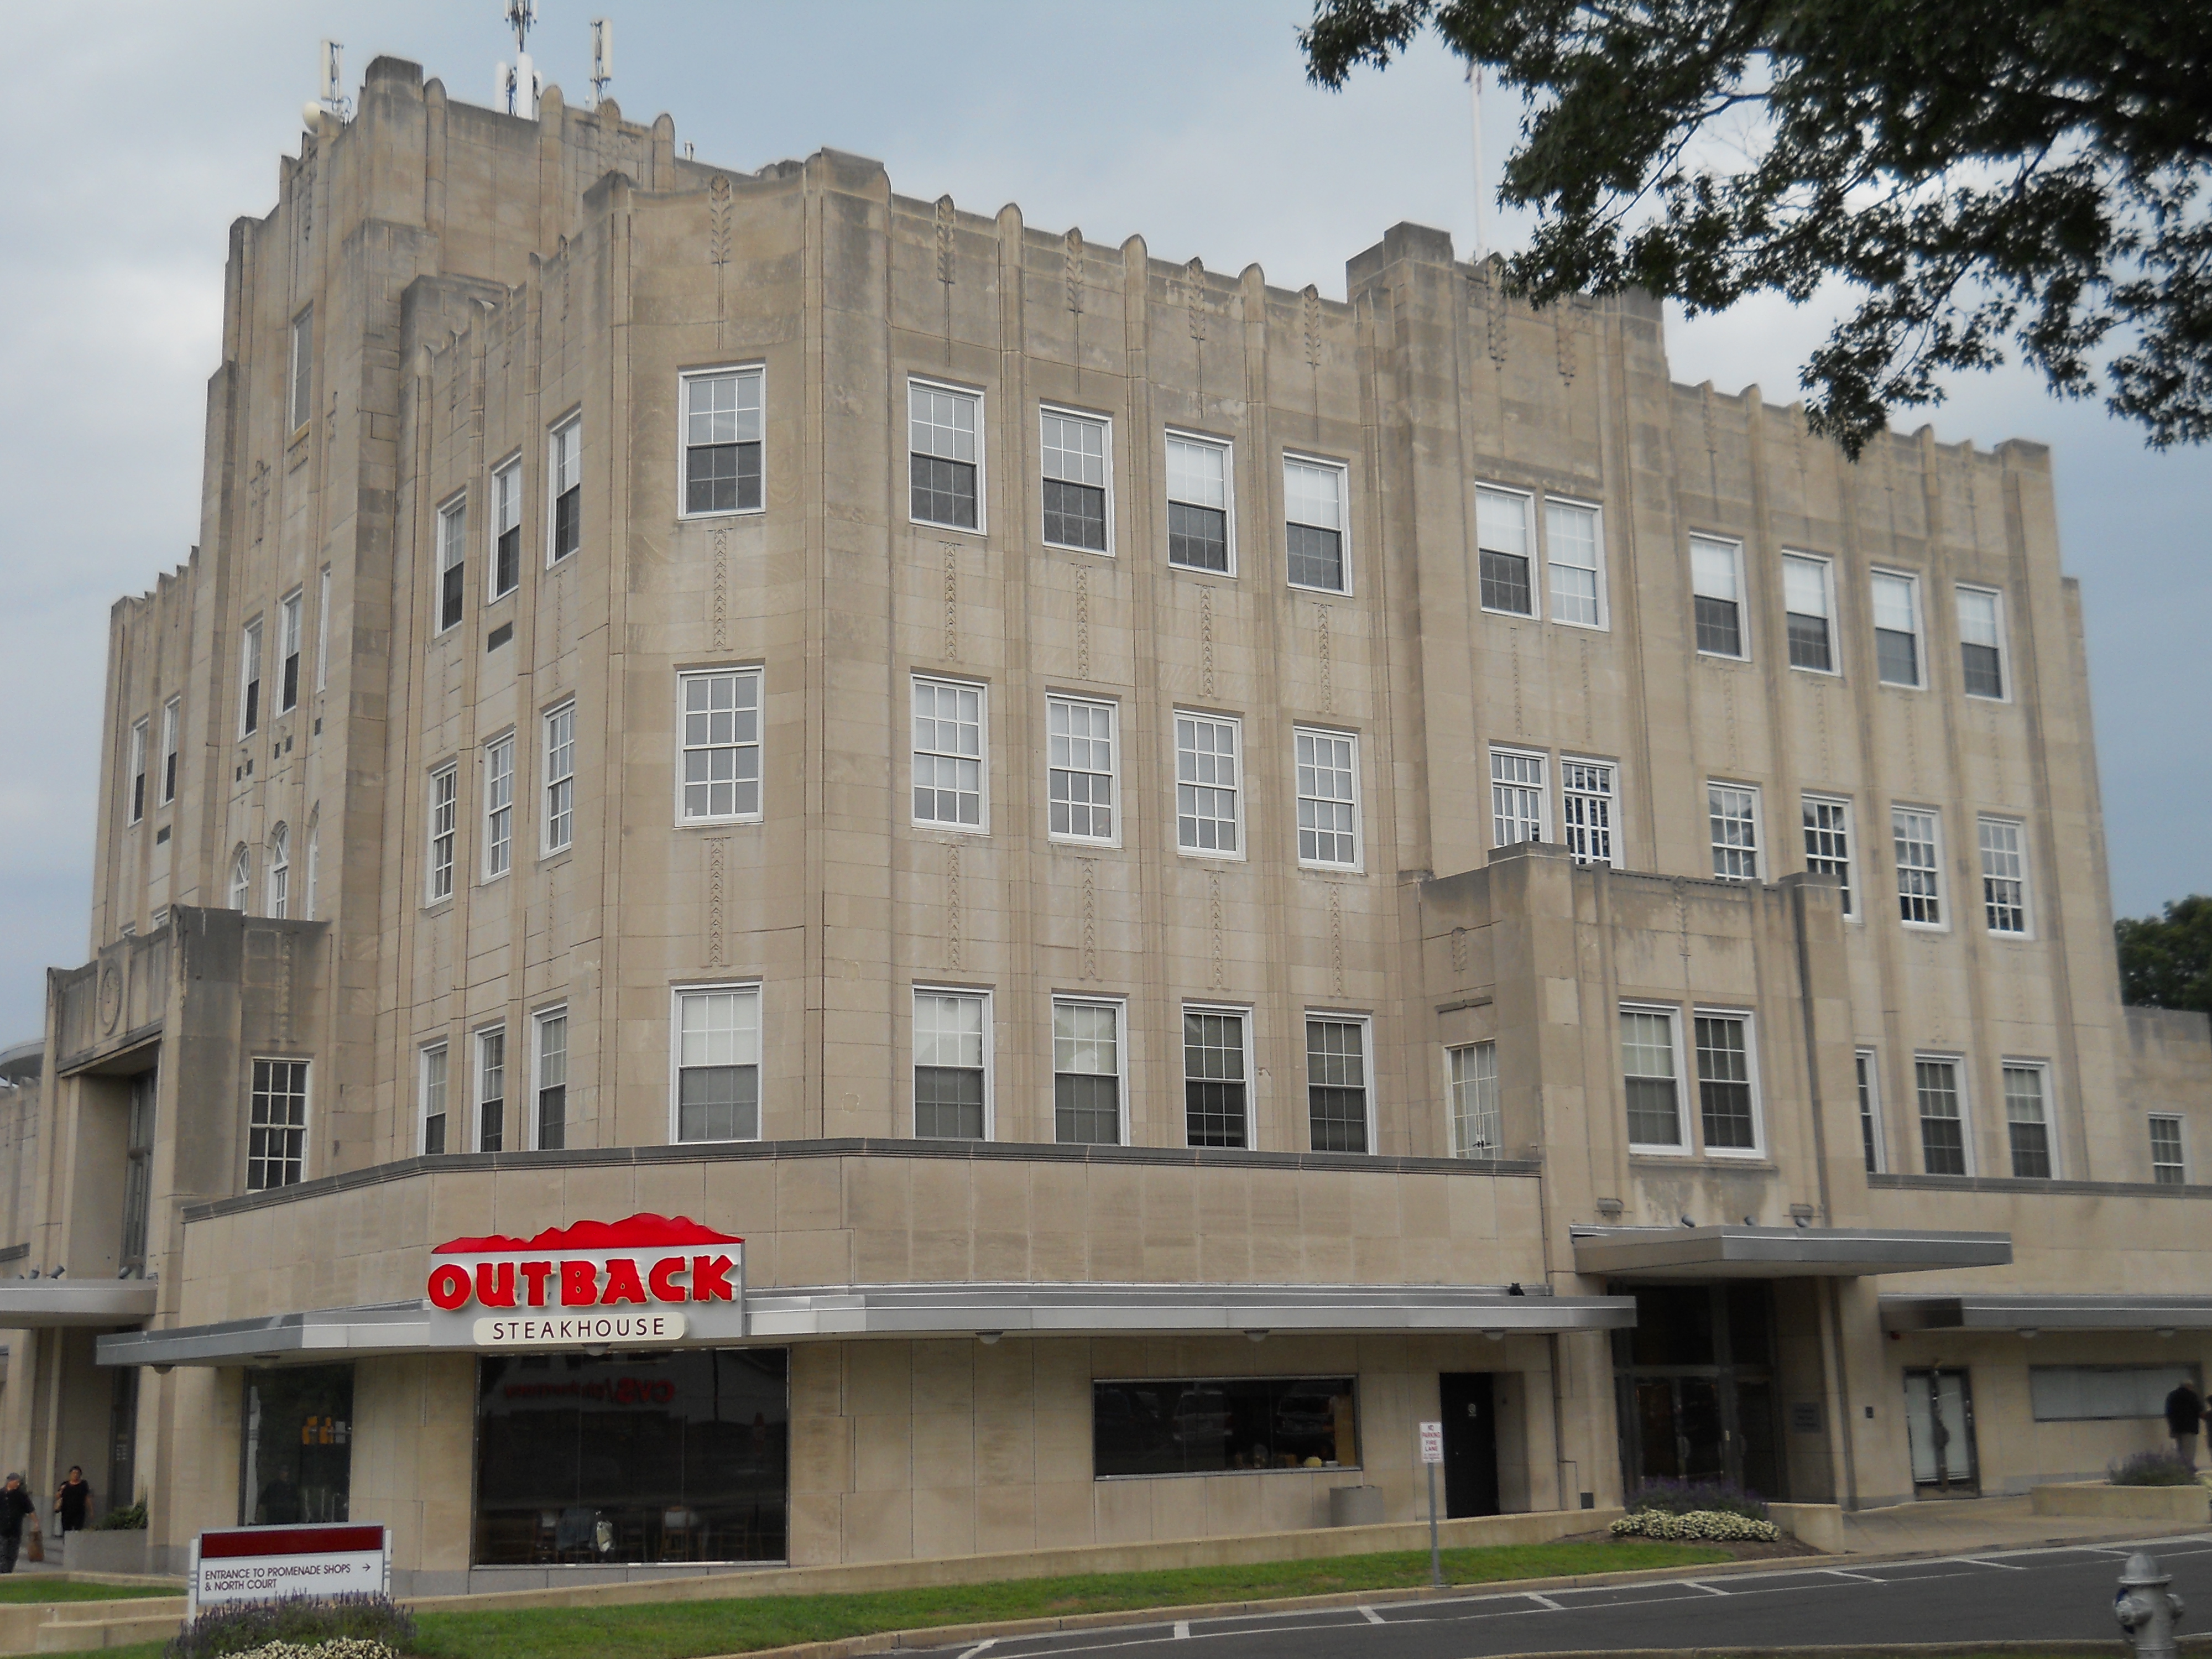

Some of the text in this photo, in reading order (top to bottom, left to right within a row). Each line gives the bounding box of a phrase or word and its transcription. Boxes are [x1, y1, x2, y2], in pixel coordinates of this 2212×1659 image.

[427, 1255, 737, 1310] OUTBACK
[493, 1317, 665, 1340] STEAKHOUSE
[205, 1563, 351, 1580] ENTRANCE TO PROMENADE SHOPS
[205, 1579, 276, 1591] & NORTH COURT
